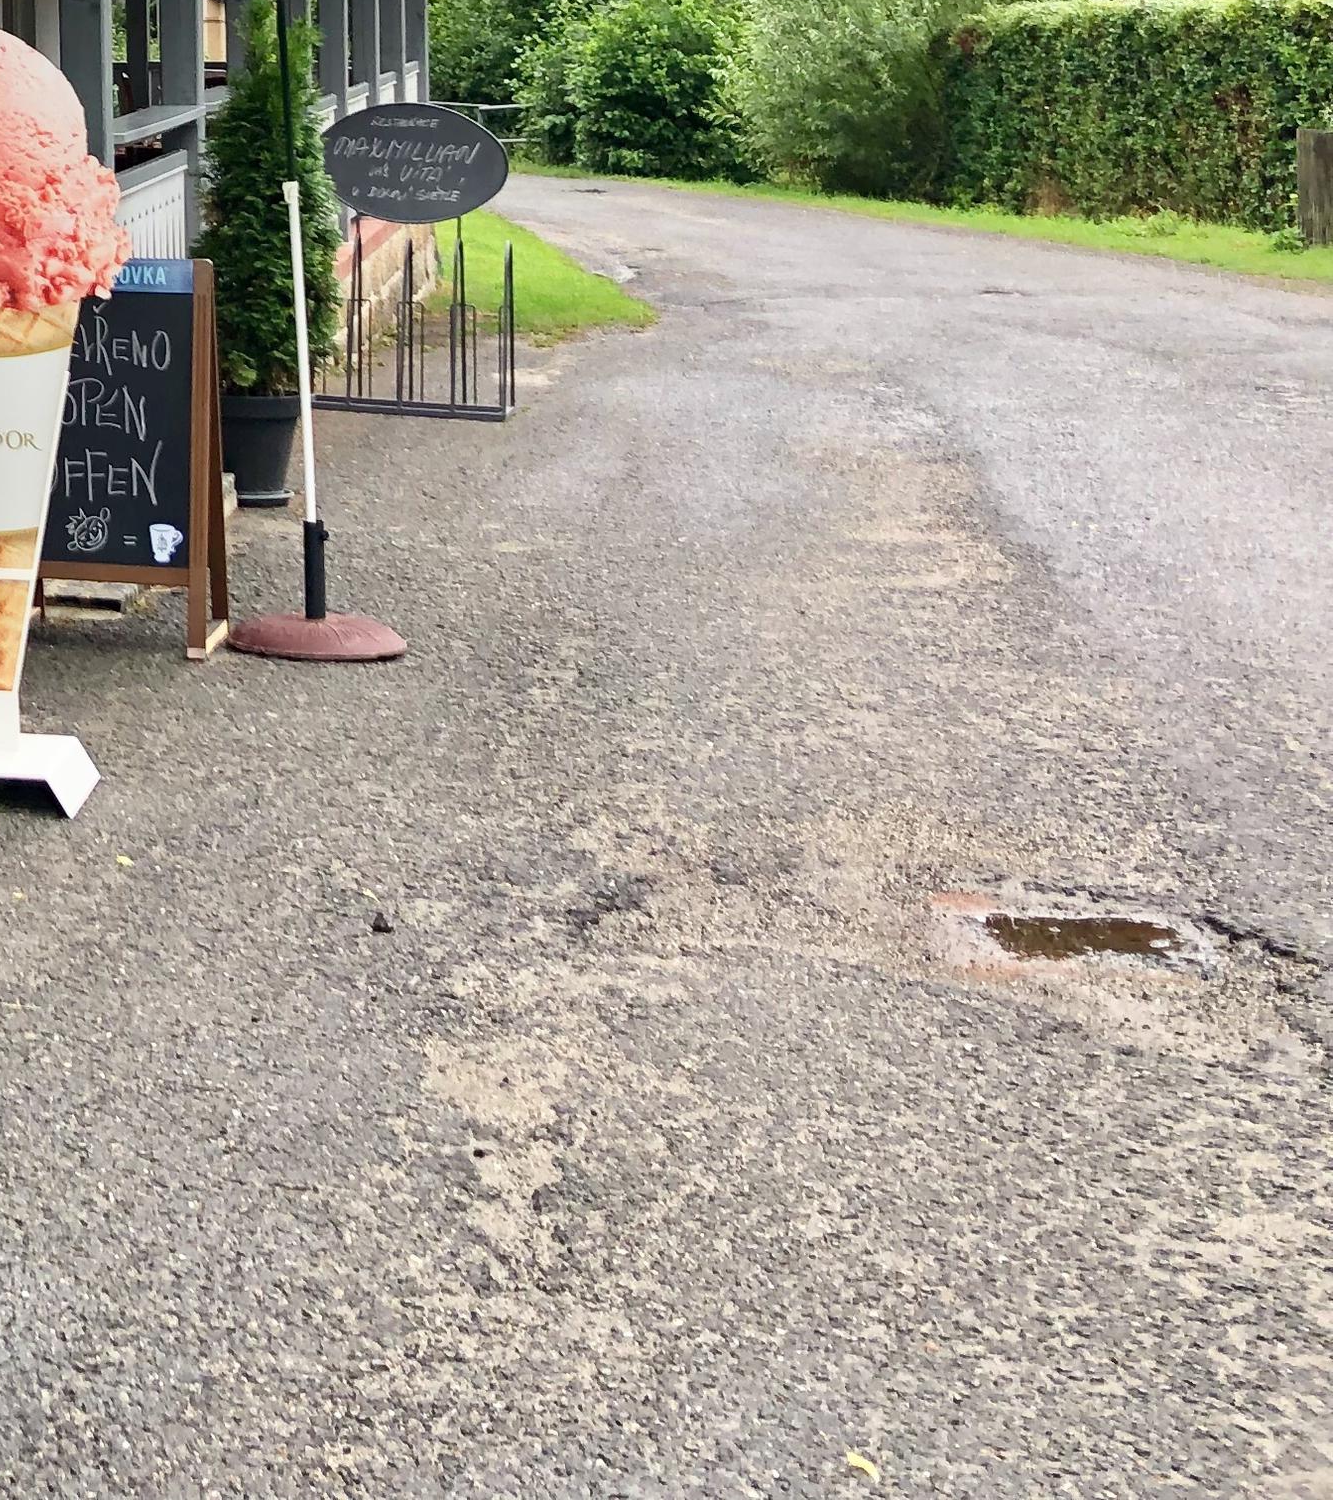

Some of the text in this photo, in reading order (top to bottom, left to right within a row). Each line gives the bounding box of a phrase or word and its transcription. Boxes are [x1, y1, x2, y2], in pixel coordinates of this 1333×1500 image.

[113, 265, 167, 285] OVKA
[71, 302, 172, 376] VŘENO
[51, 440, 164, 506] FFEN
